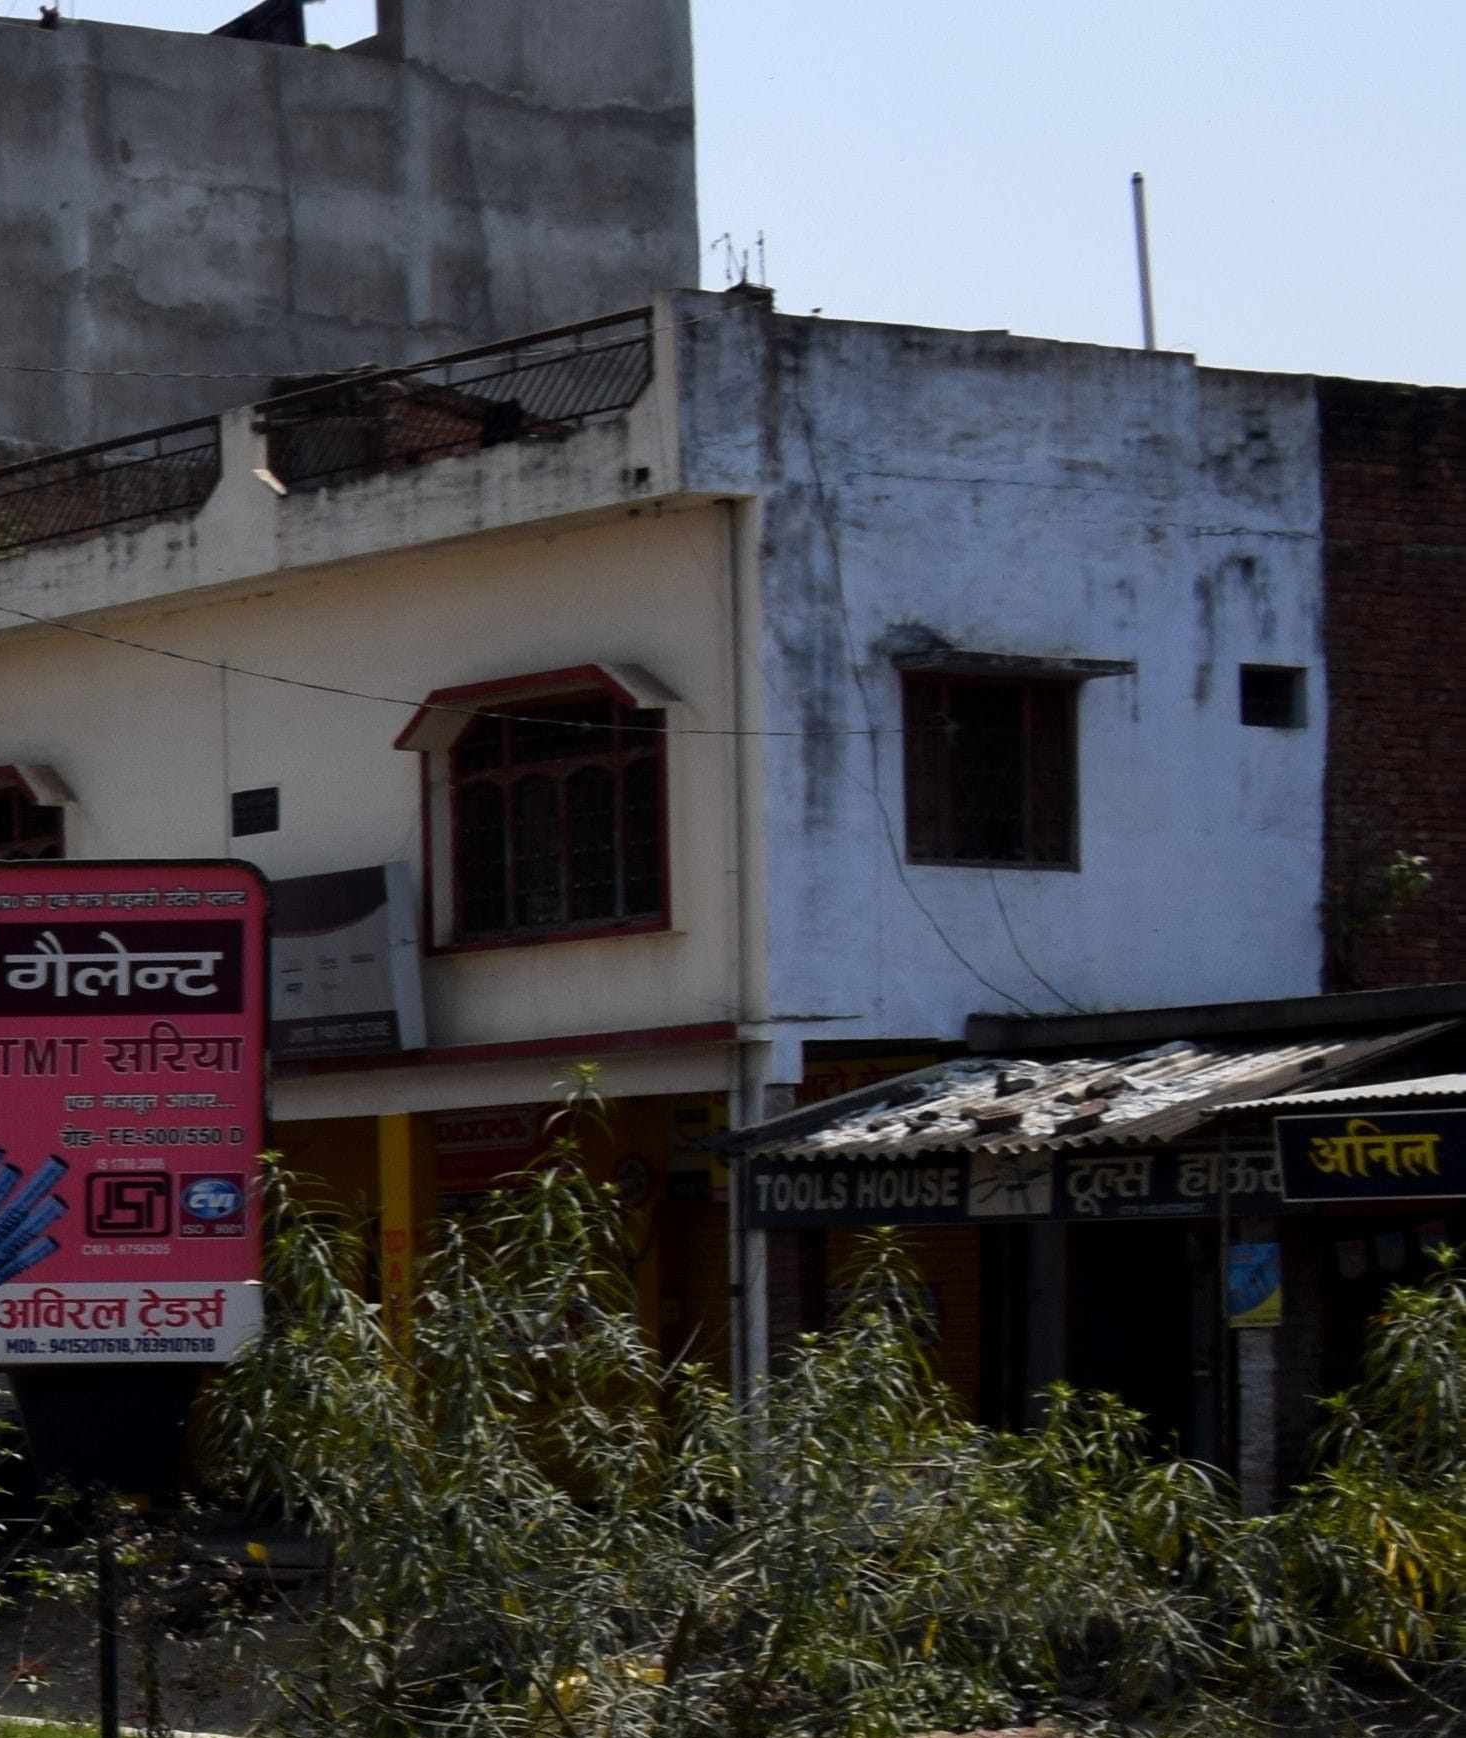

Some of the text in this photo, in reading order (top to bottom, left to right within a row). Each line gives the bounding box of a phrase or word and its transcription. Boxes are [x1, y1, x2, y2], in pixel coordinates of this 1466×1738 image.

[4, 930, 224, 998] गैलेन्ट
[102, 1020, 245, 1075] सरिया
[228, 1127, 246, 1146] D
[1308, 1120, 1445, 1179] अनिल
[755, 1167, 961, 1212] TOOLS HOUSE
[1066, 1154, 1155, 1216] टूल्स
[182, 1223, 204, 1236] ISO
[137, 1288, 226, 1336] ट्रेडर्स
